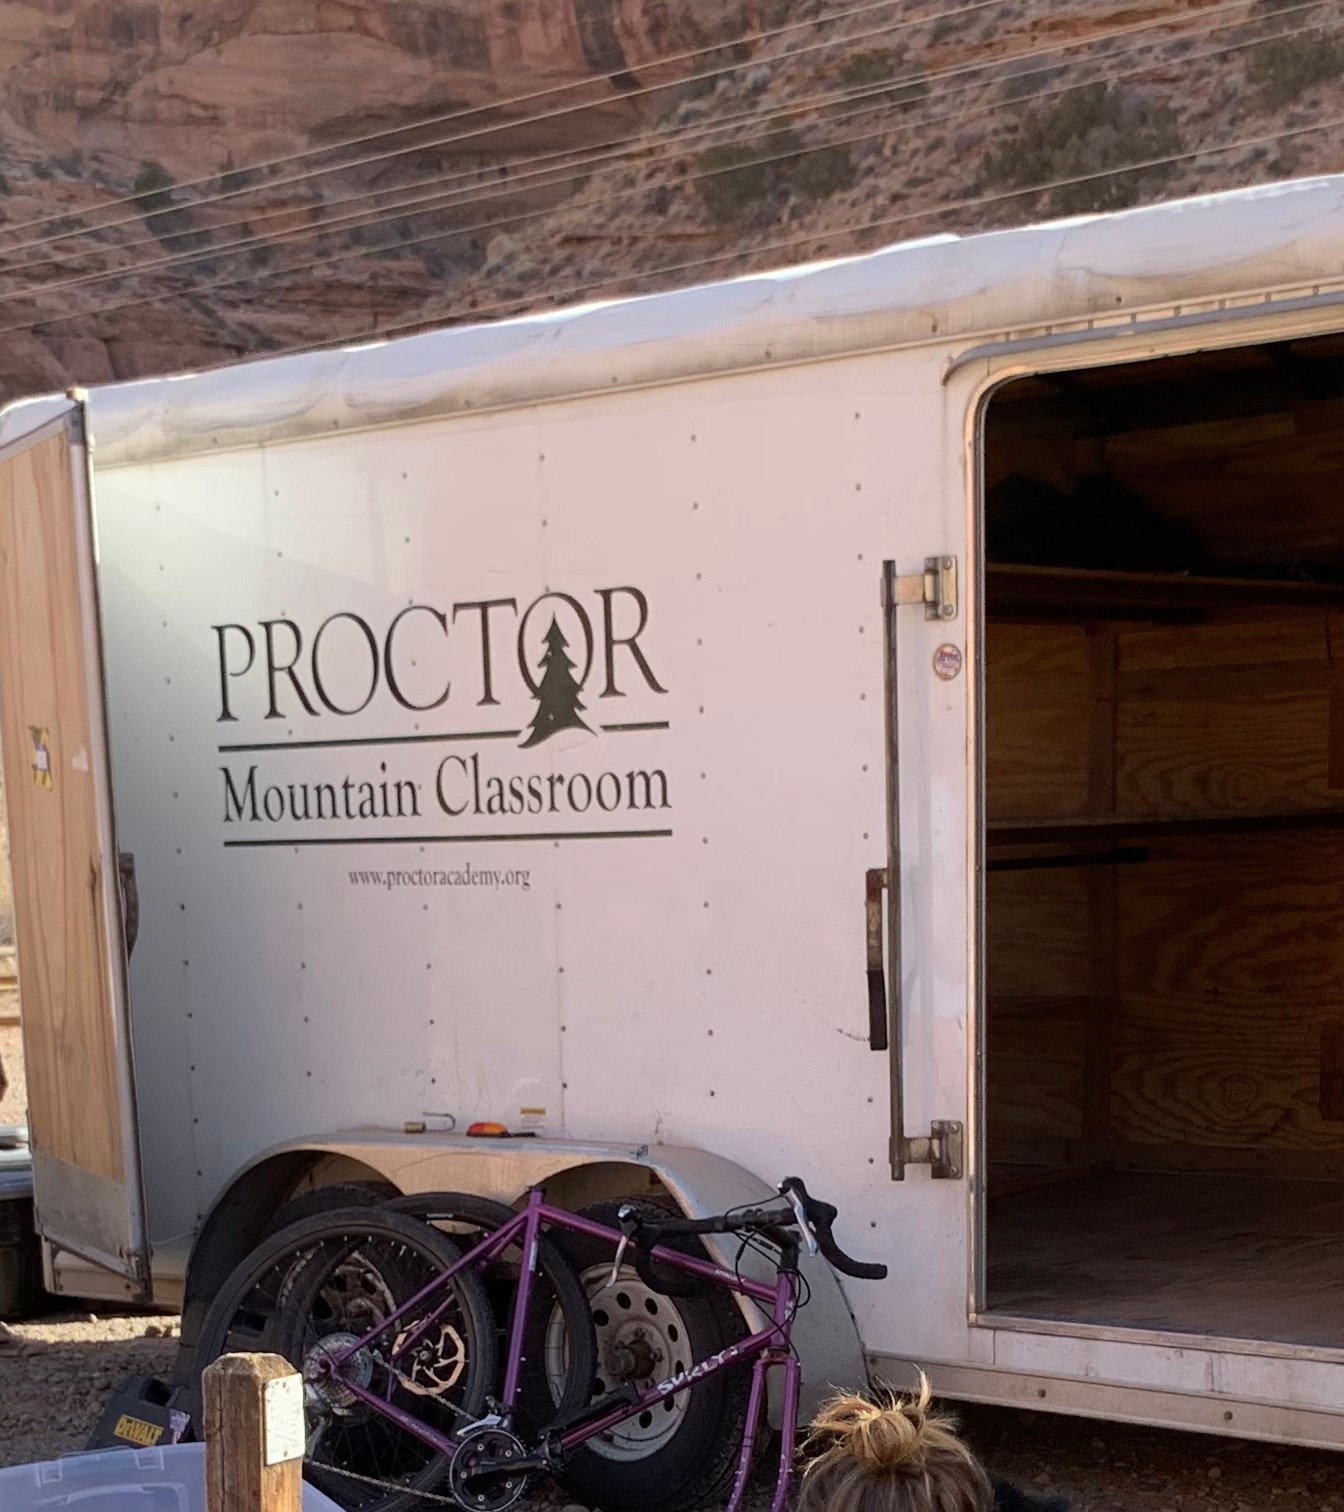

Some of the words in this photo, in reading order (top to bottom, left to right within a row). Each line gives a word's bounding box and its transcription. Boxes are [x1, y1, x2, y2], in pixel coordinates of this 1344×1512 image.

[210, 585, 670, 722] PROCTOR
[219, 760, 422, 823] Mountain
[435, 752, 673, 818] Classroom
[348, 862, 531, 890] www.proctoracademy.org
